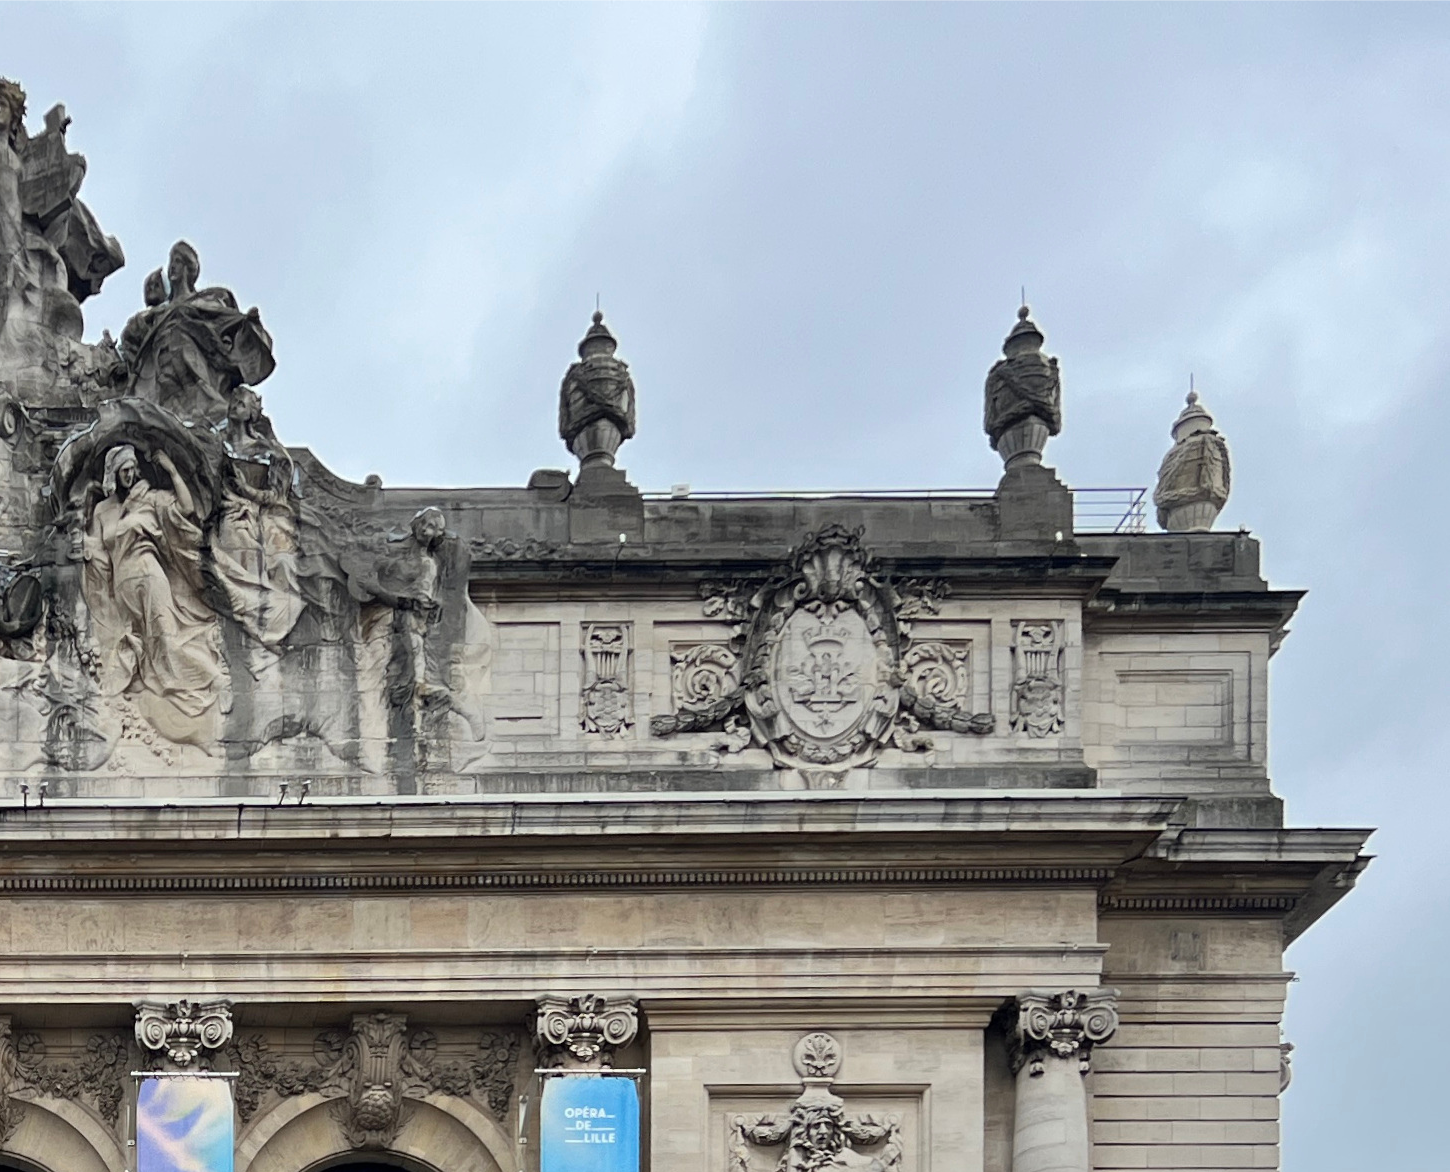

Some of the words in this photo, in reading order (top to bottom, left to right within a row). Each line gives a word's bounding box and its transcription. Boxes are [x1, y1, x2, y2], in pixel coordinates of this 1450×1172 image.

[564, 1106, 606, 1118] OPÉRA
[576, 1121, 592, 1130] DE
[584, 1133, 615, 1143] LILLE
